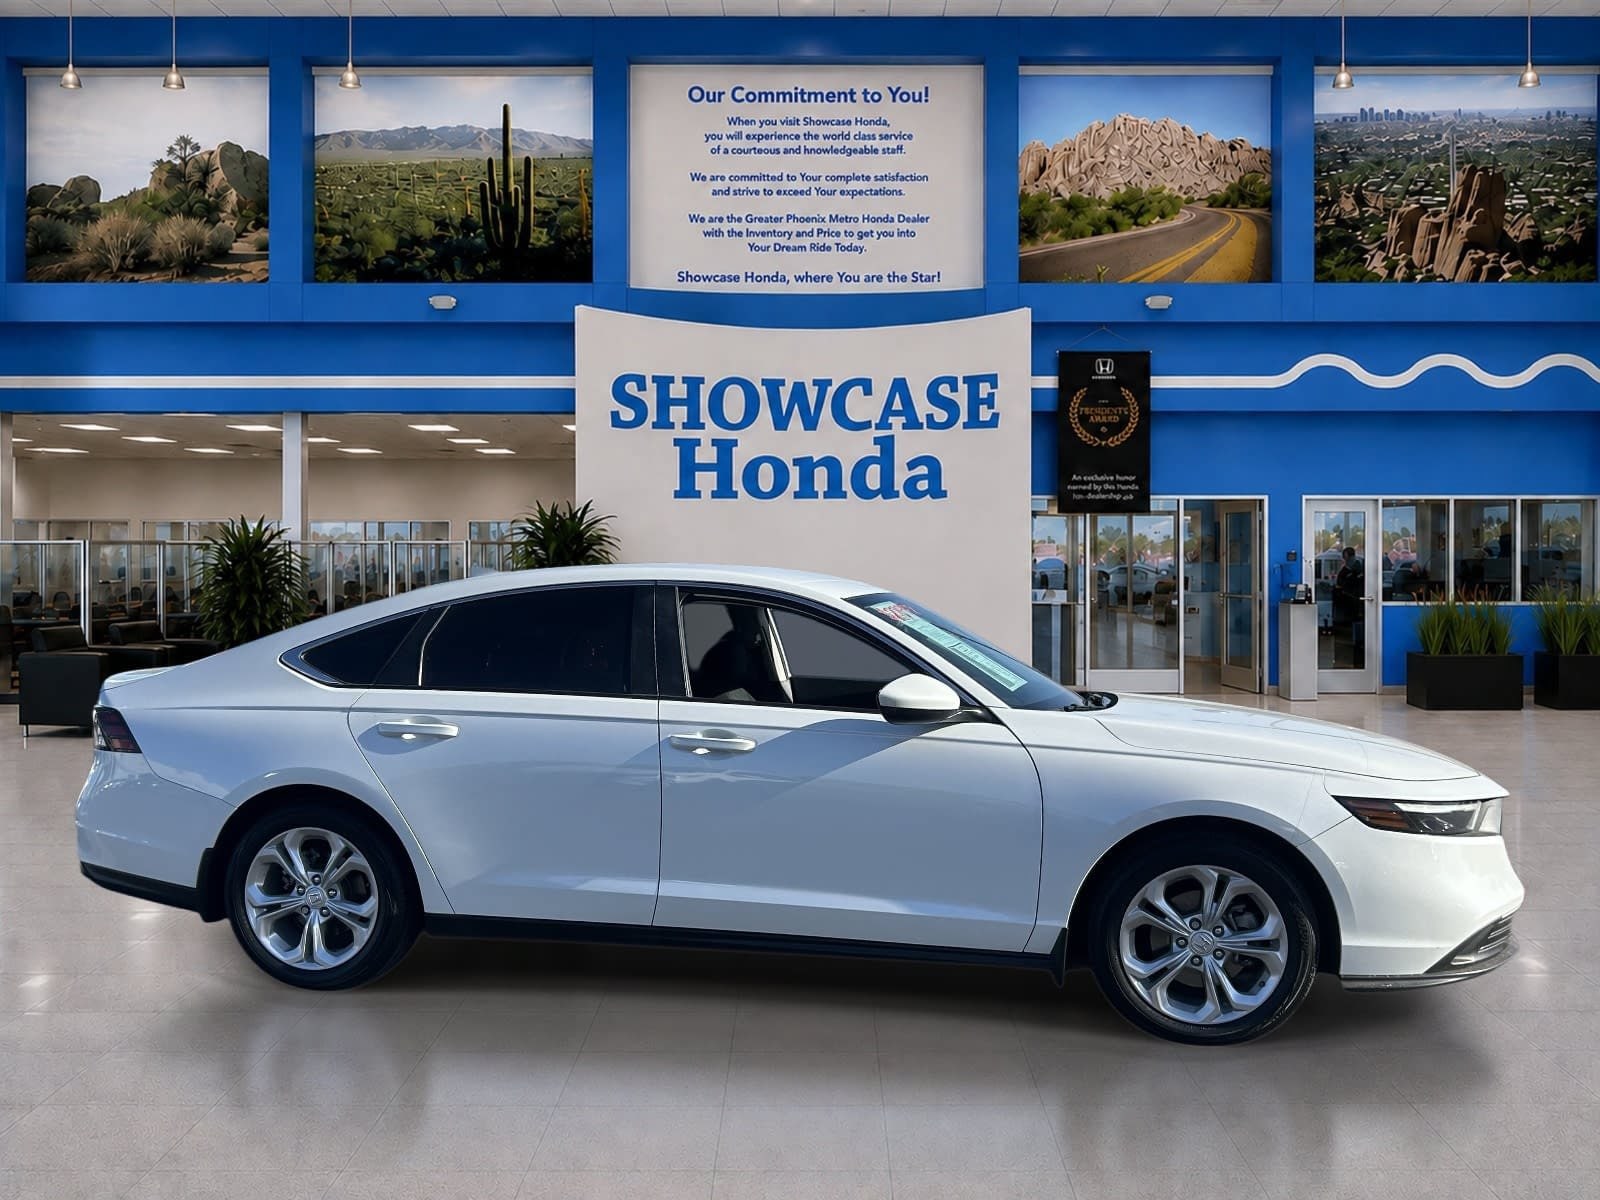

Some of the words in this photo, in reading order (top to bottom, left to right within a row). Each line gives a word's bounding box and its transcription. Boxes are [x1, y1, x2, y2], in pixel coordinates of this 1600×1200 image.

[688, 85, 726, 103] Our
[731, 86, 857, 103] Commitment
[861, 88, 883, 103] to
[887, 86, 929, 103] You!
[727, 116, 756, 126] When
[759, 119, 777, 129] you
[779, 116, 801, 126] visit
[803, 116, 852, 126] Showcase
[855, 116, 890, 128] Honda,
[704, 133, 723, 143] you
[725, 130, 743, 141] will
[745, 131, 801, 143] experience
[803, 131, 820, 141] the
[822, 131, 851, 141] world
[853, 131, 877, 141] class
[878, 131, 913, 141] service
[710, 144, 721, 155] of
[723, 147, 729, 155] a
[731, 147, 781, 155] courteous
[783, 145, 801, 155] and
[881, 144, 906, 155] staff.
[690, 172, 707, 182] We
[728, 172, 783, 182] committed
[786, 173, 797, 182] to
[799, 172, 822, 182] Your
[825, 172, 871, 185] complete
[873, 172, 929, 182] satisfaction
[712, 186, 731, 196] and
[732, 186, 760, 196] strive
[763, 188, 774, 196] to
[776, 186, 812, 196] exceed
[814, 186, 838, 196] Your
[839, 186, 905, 200] expectations.
[688, 214, 706, 224] We
[708, 216, 724, 224] are
[726, 213, 743, 223] the
[745, 213, 784, 224] Greater
[786, 213, 826, 224] Phoenix
[829, 214, 859, 223] Metro
[862, 213, 895, 223] Honda
[897, 213, 930, 223] Dealer
[702, 228, 725, 238] with
[727, 228, 744, 238] the
[746, 228, 793, 240] Inventory
[795, 228, 814, 238] and
[816, 228, 841, 238] Price
[844, 230, 855, 238] to
[856, 229, 874, 240] get
[876, 230, 894, 240] you
[897, 228, 916, 238] into
[747, 242, 771, 252] Your
[773, 242, 807, 252] Dream
[809, 242, 832, 252] Ride
[834, 242, 867, 255] Today.
[677, 270, 740, 283] Showcase
[744, 271, 790, 285] Honda,
[794, 271, 834, 283] where
[837, 272, 860, 283] You
[864, 274, 883, 283] are
[886, 271, 908, 283] the
[911, 271, 941, 283] Star!
[610, 373, 1000, 431] SHOWCASE
[673, 434, 948, 500] Honda
[1093, 483, 1102, 492] by
